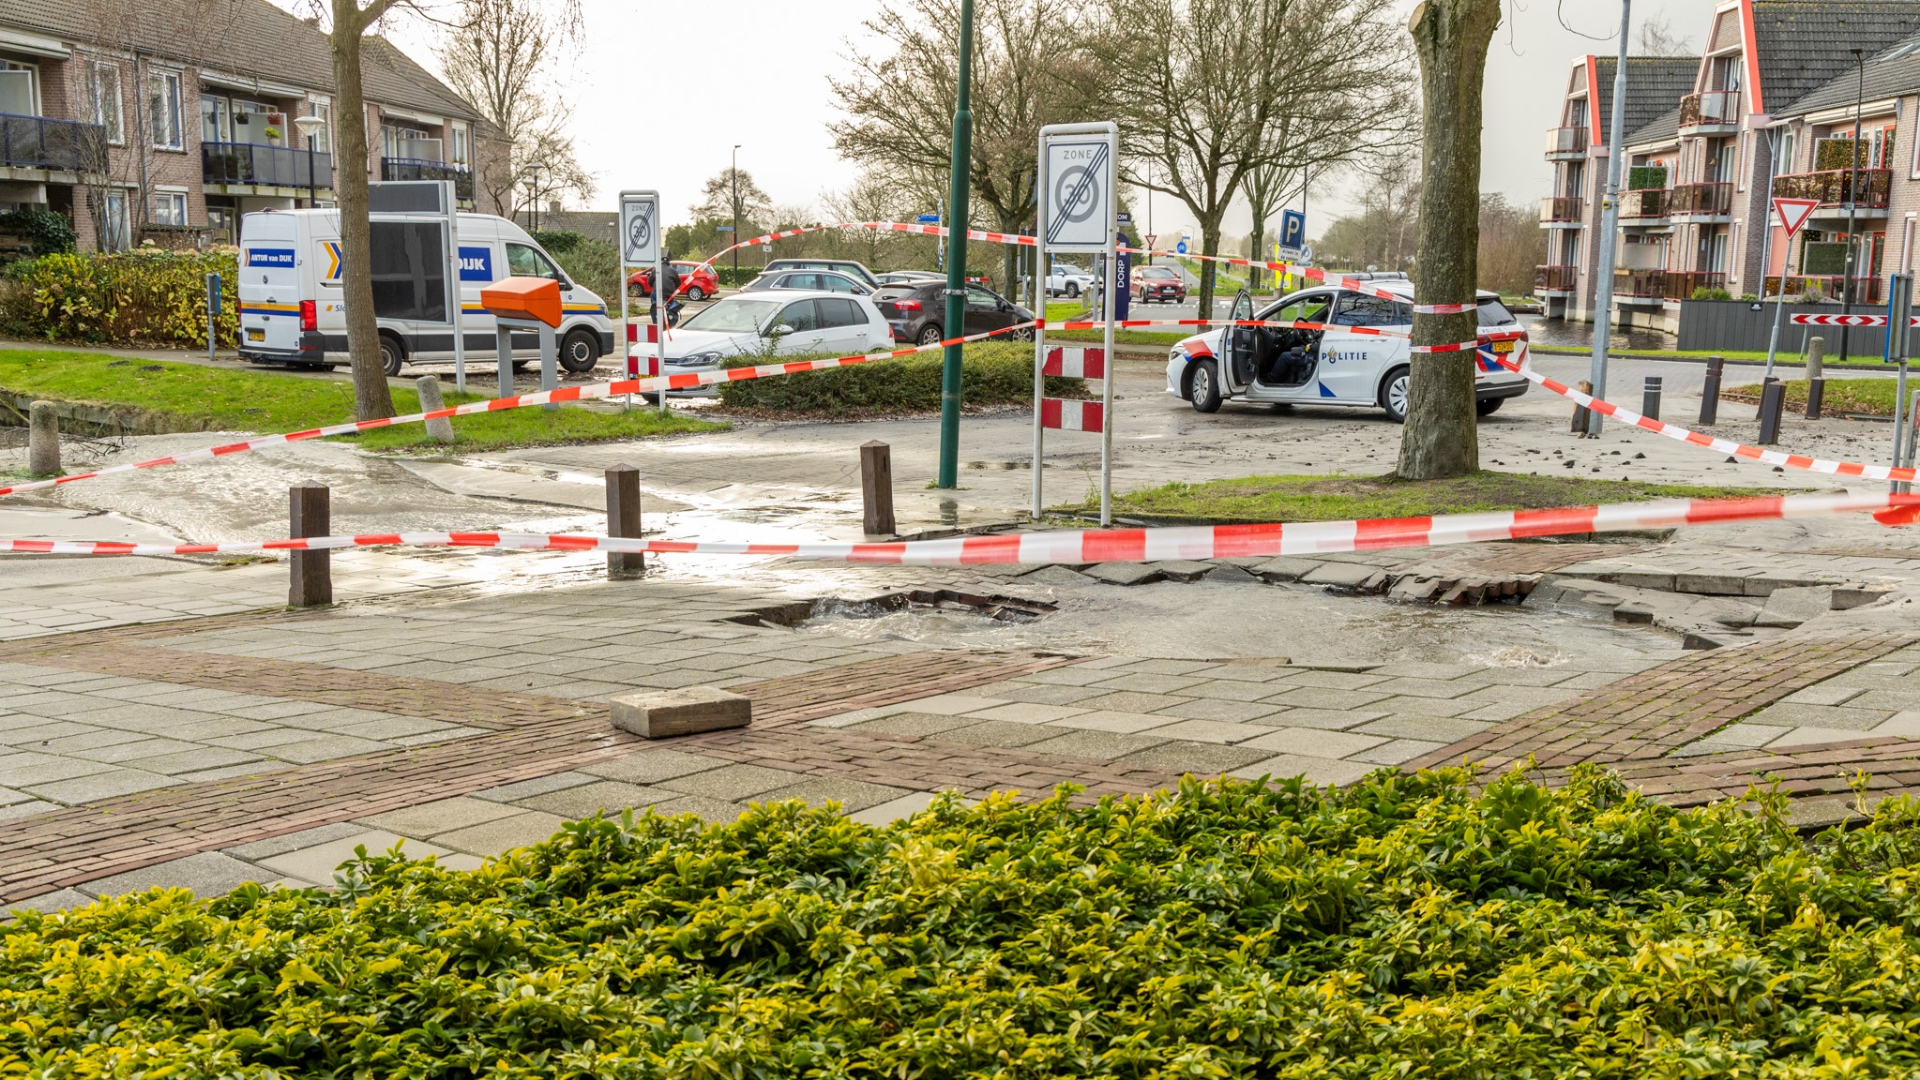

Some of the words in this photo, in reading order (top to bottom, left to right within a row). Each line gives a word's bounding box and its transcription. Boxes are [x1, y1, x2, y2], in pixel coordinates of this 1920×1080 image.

[1063, 149, 1093, 160] ZONE
[1063, 183, 1091, 205] 30
[631, 204, 647, 212] ZONE
[633, 225, 647, 239] 30
[1285, 215, 1300, 243] P
[251, 254, 268, 262] ANTON
[279, 254, 293, 263] DIJK
[1117, 259, 1126, 288] DORP
[1321, 351, 1368, 364] POLITIE
